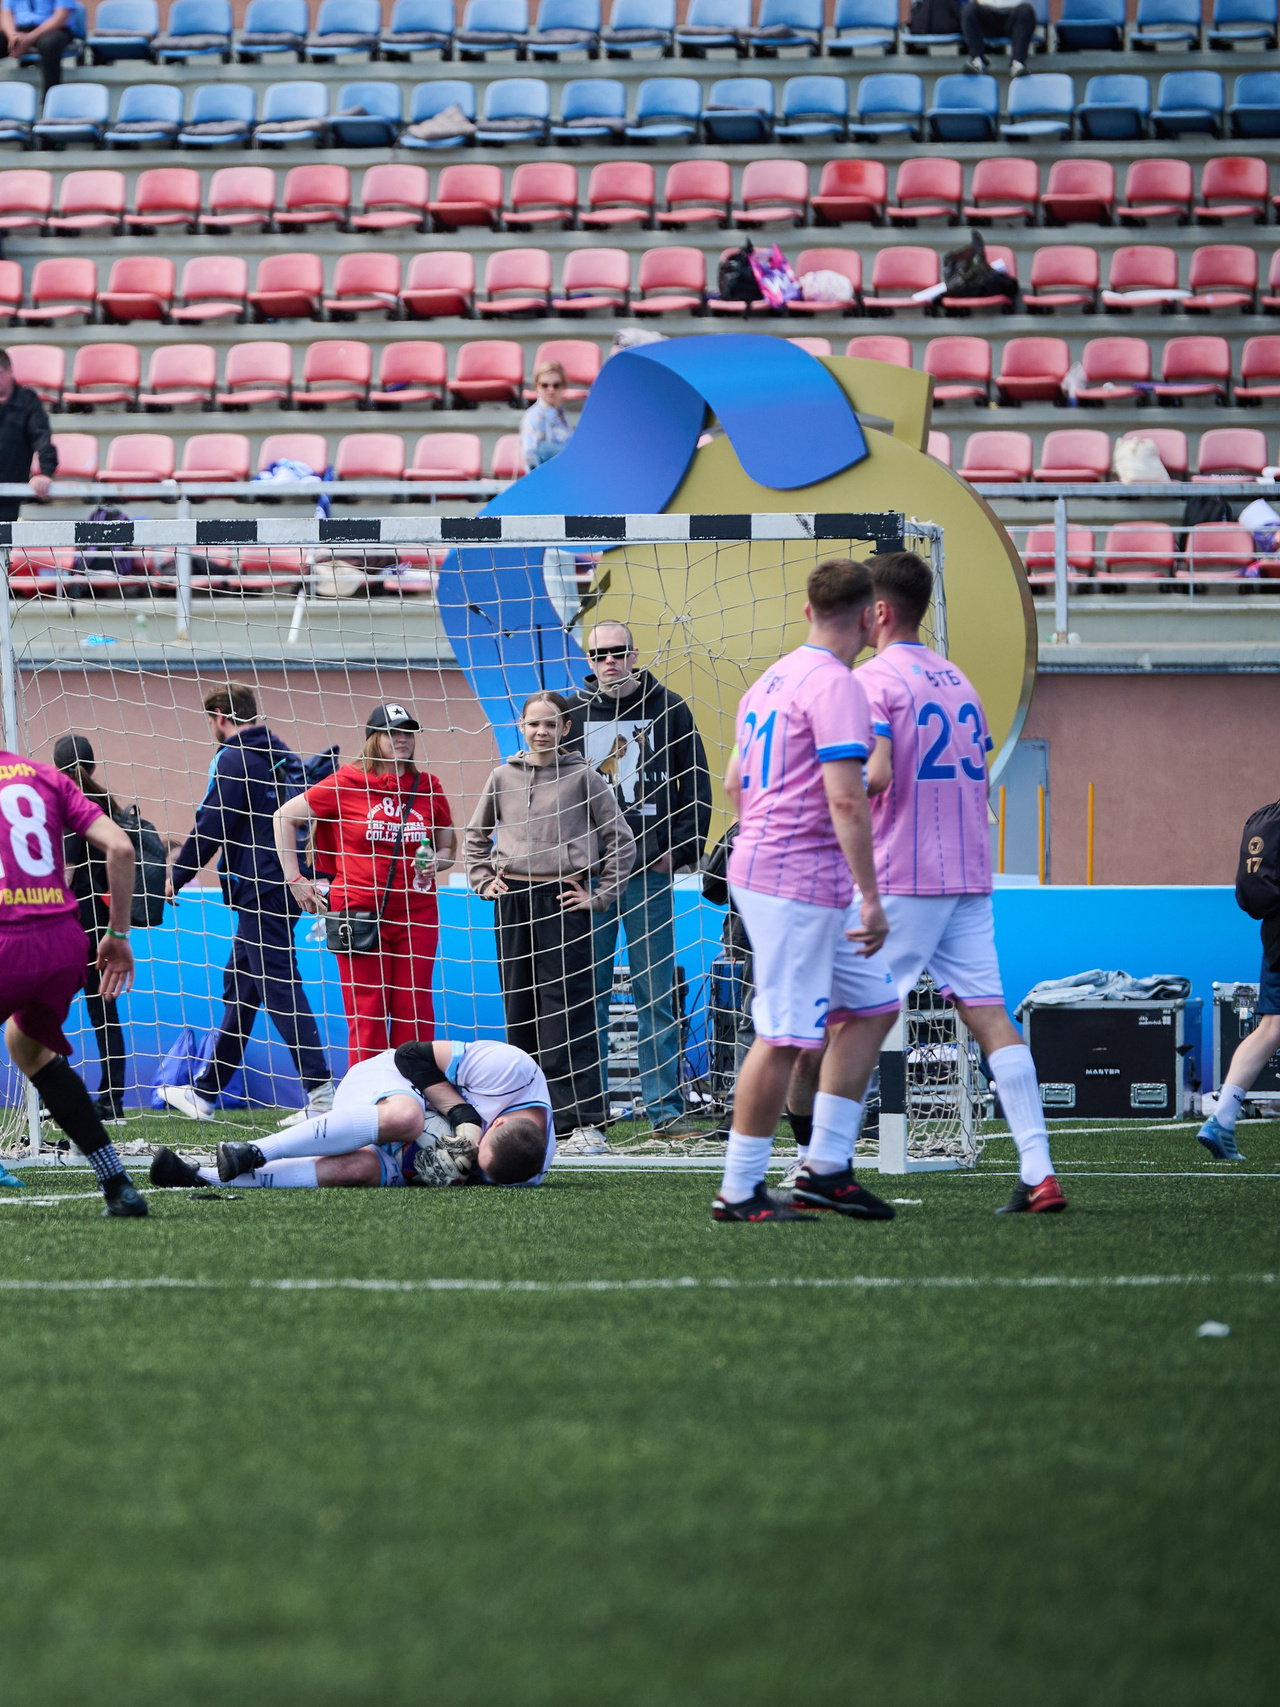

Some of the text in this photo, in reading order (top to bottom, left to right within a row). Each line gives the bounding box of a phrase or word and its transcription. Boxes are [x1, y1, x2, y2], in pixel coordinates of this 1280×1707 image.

[916, 701, 986, 782] 23
[740, 710, 778, 791] 21
[387, 822, 427, 832] ORIINAL
[365, 830, 427, 843] COLLETION
[1246, 857, 1263, 874] 17
[1085, 1068, 1121, 1076] MASTER
